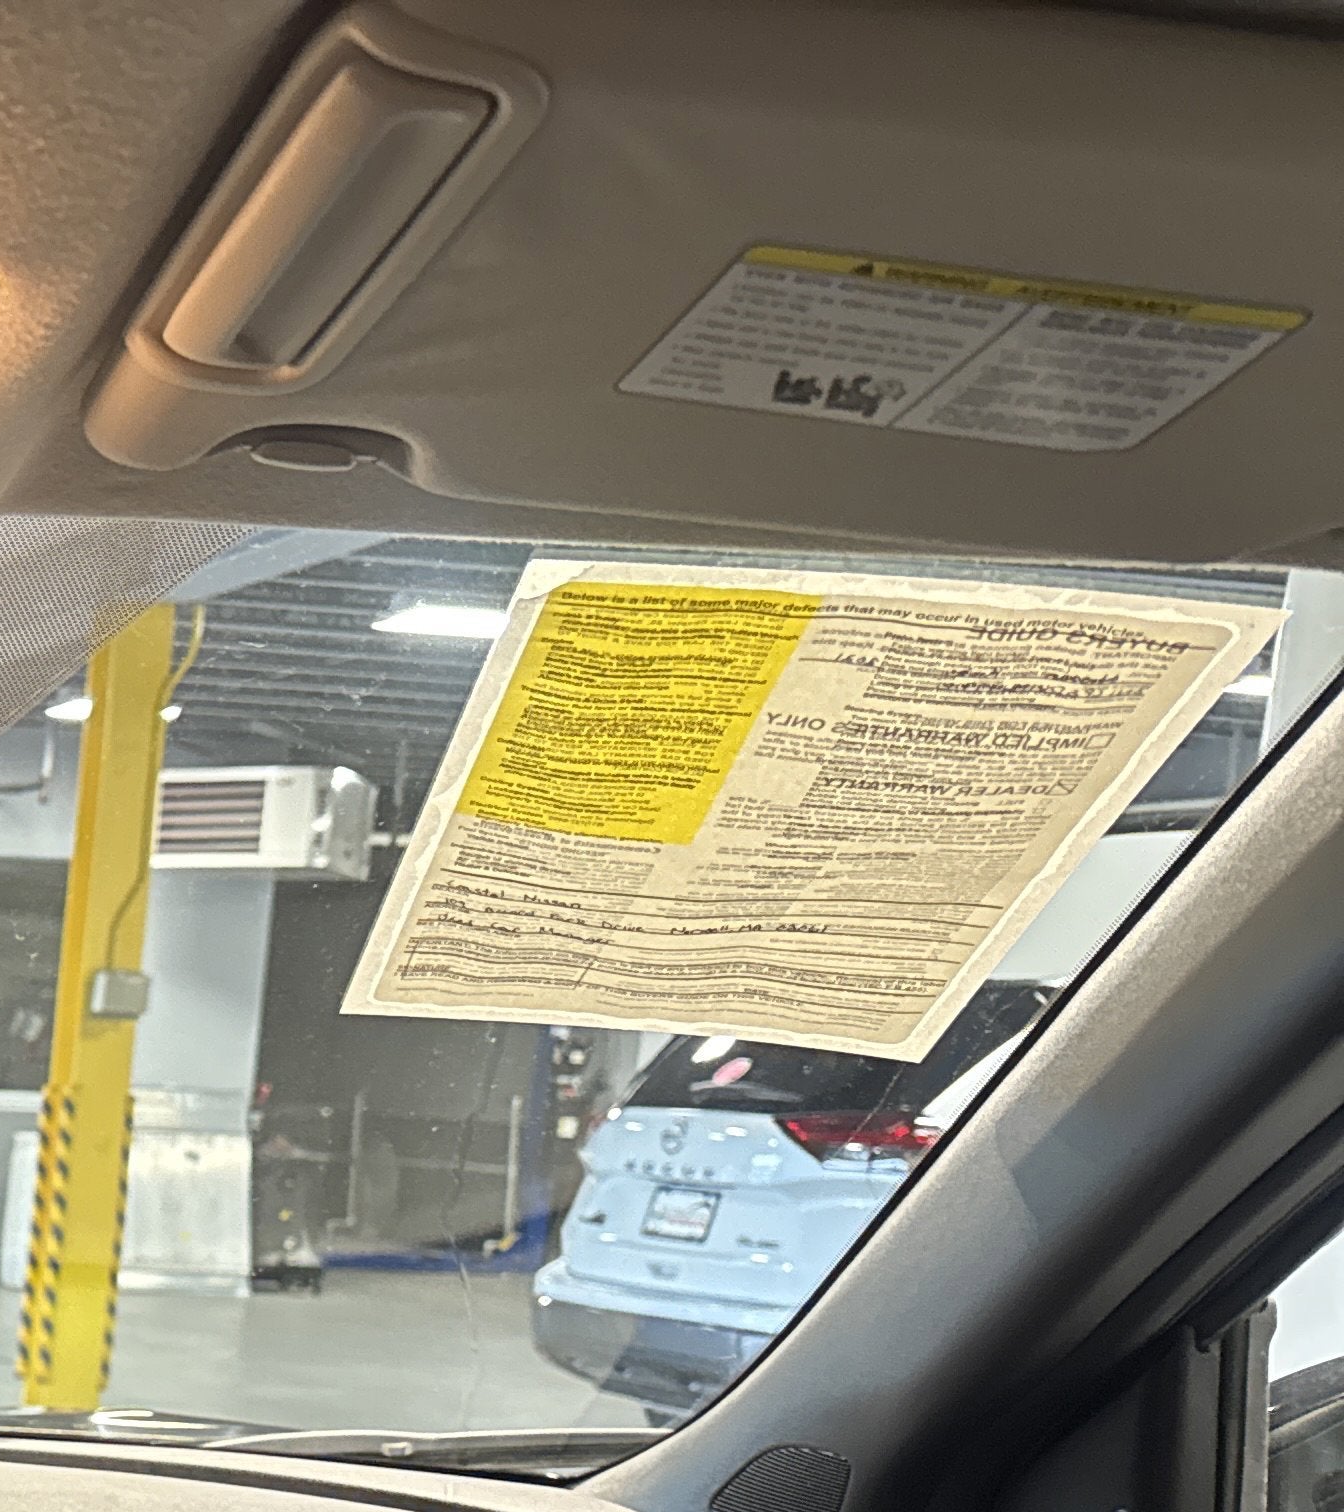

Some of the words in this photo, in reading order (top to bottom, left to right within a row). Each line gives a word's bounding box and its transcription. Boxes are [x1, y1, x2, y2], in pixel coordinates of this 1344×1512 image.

[561, 591, 608, 602] Below
[735, 599, 779, 610] major
[844, 604, 875, 614] that
[878, 607, 911, 618] may
[915, 612, 960, 623] occur
